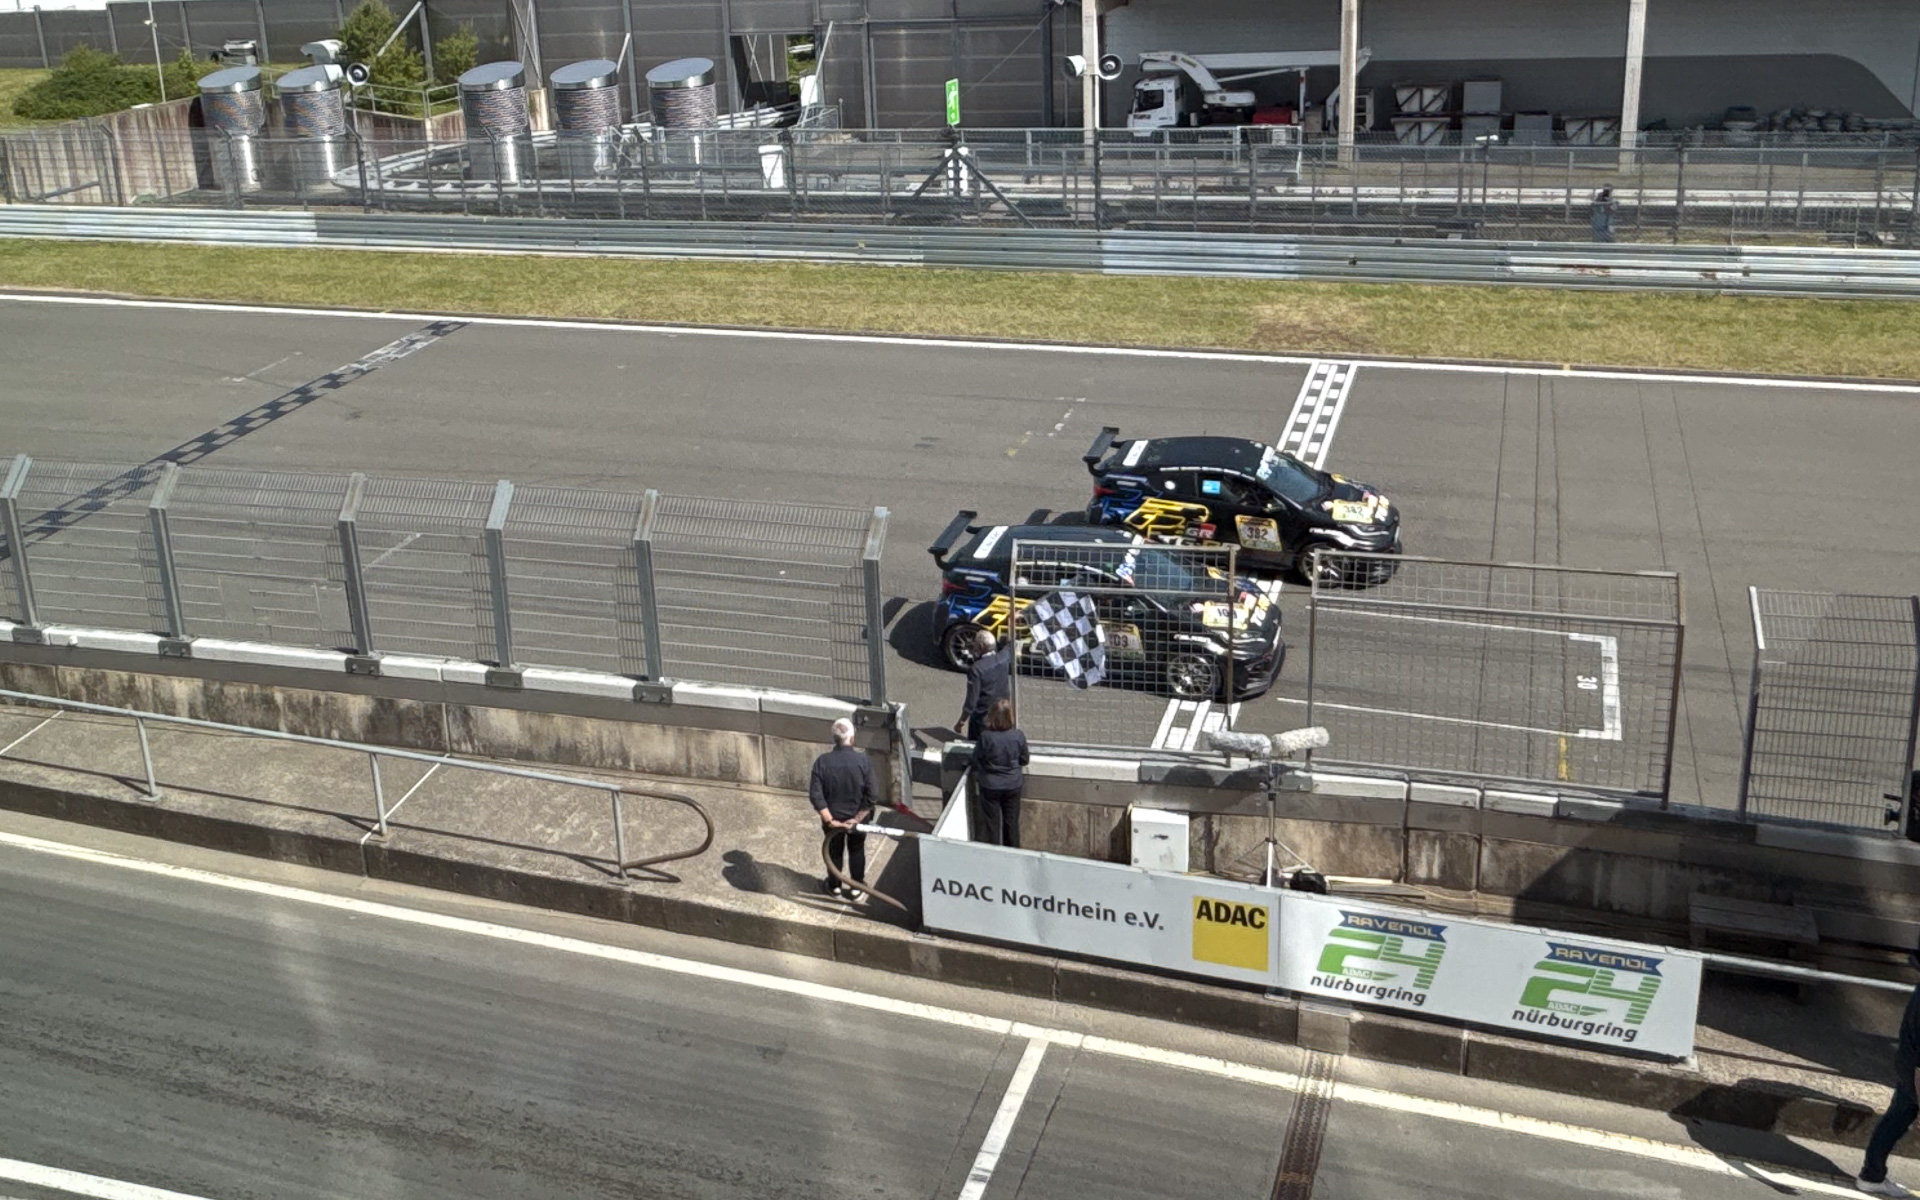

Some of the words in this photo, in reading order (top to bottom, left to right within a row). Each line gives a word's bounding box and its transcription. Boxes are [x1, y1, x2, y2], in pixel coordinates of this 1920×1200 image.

[931, 877, 994, 902] ADAC
[1001, 888, 1116, 923] Nordrhein
[1124, 911, 1165, 931] e.V.
[1196, 899, 1266, 930] ADAC
[1347, 915, 1438, 938] RAVENOL
[1341, 967, 1371, 979] ADAC
[1555, 948, 1653, 971] RAVENOL
[1310, 975, 1427, 1007] nürburgring
[1511, 1008, 1639, 1043] nürburgring
